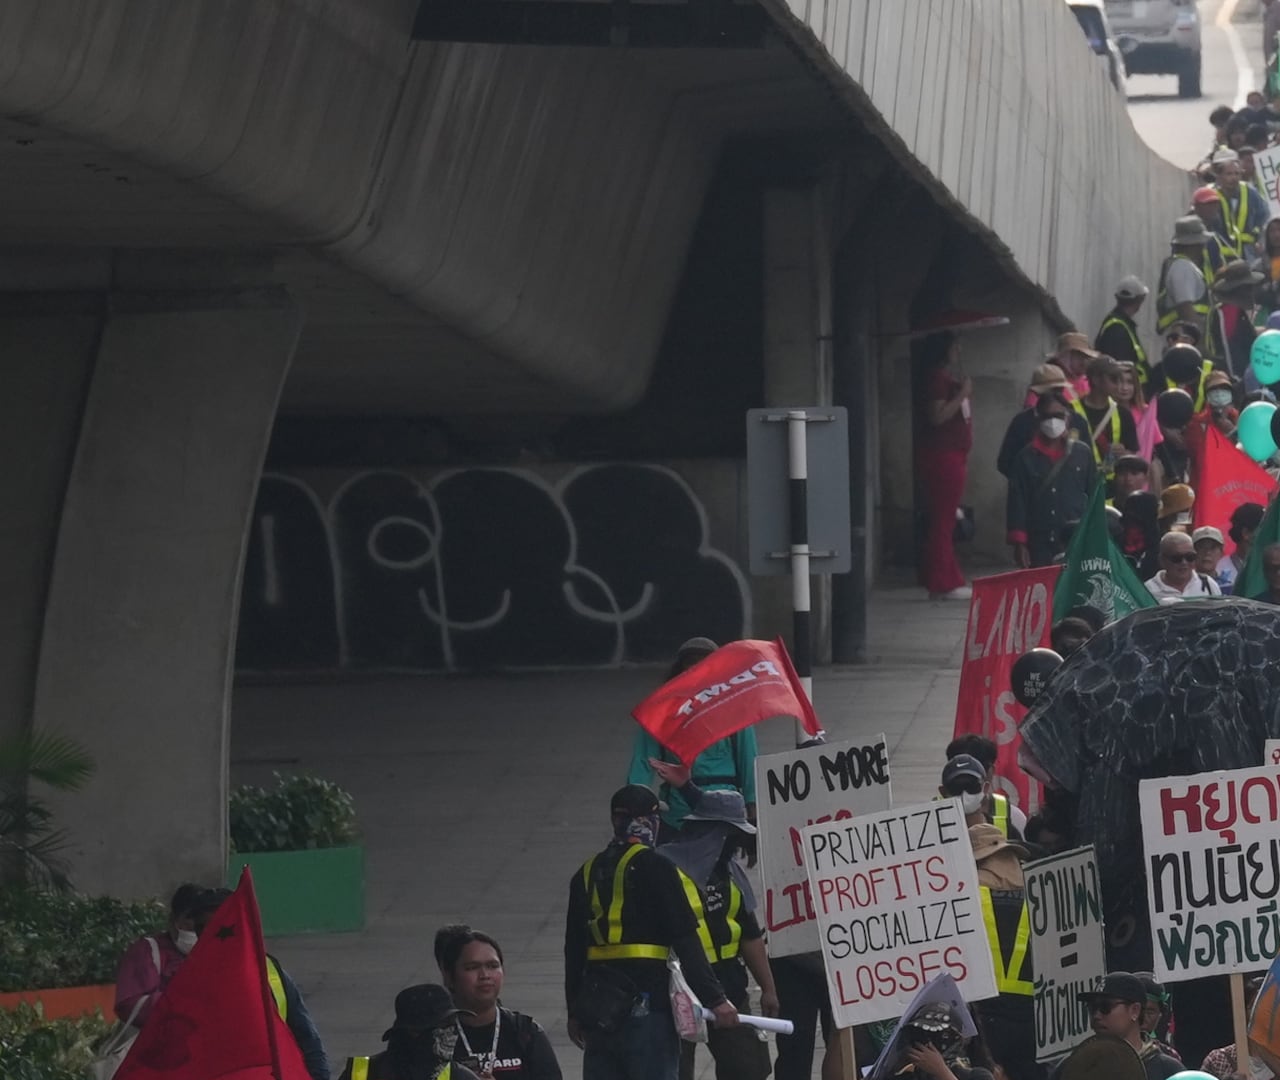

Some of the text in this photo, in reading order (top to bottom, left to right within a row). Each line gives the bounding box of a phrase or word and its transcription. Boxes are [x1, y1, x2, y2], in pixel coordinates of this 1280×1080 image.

[967, 582, 1048, 661] LAND
[982, 675, 1017, 746] is
[766, 742, 890, 806] NO MORE
[811, 804, 960, 872] PRIVATIZE
[818, 855, 966, 915] PROFITS,
[826, 896, 976, 960] SOCIALIZE
[835, 945, 968, 1007] LOSSES
